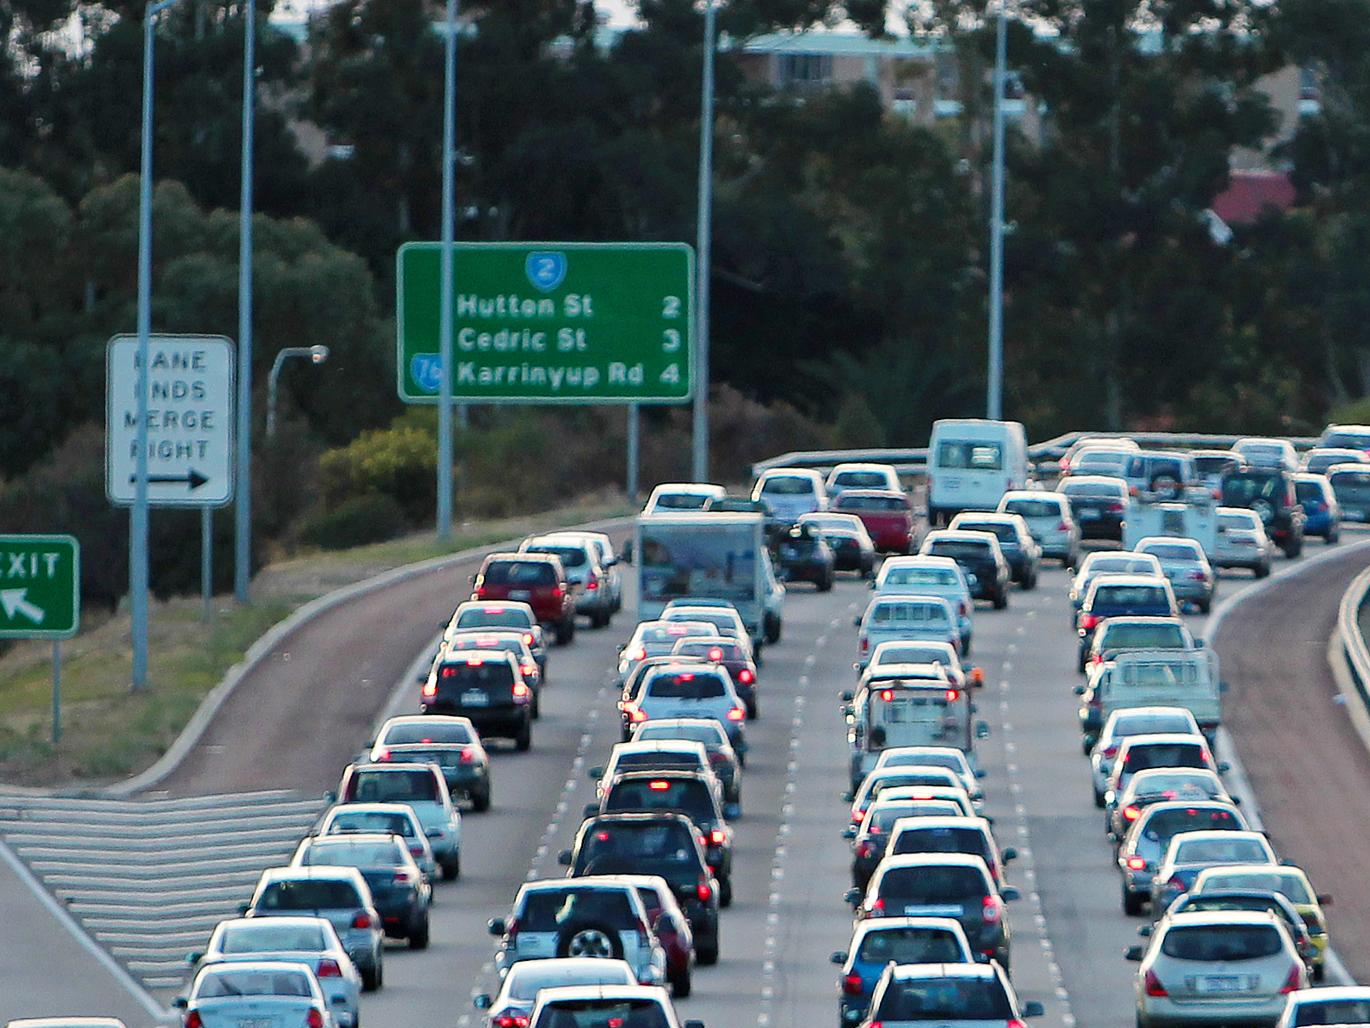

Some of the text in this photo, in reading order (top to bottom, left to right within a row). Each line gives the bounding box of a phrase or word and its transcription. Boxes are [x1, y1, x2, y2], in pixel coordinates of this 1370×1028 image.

[537, 257, 556, 279] 2
[456, 292, 682, 319] Hutton St 2
[457, 327, 682, 352] Cedric St 3
[457, 360, 681, 392] Karrinyup Rd 4
[0, 551, 60, 578] XIT
